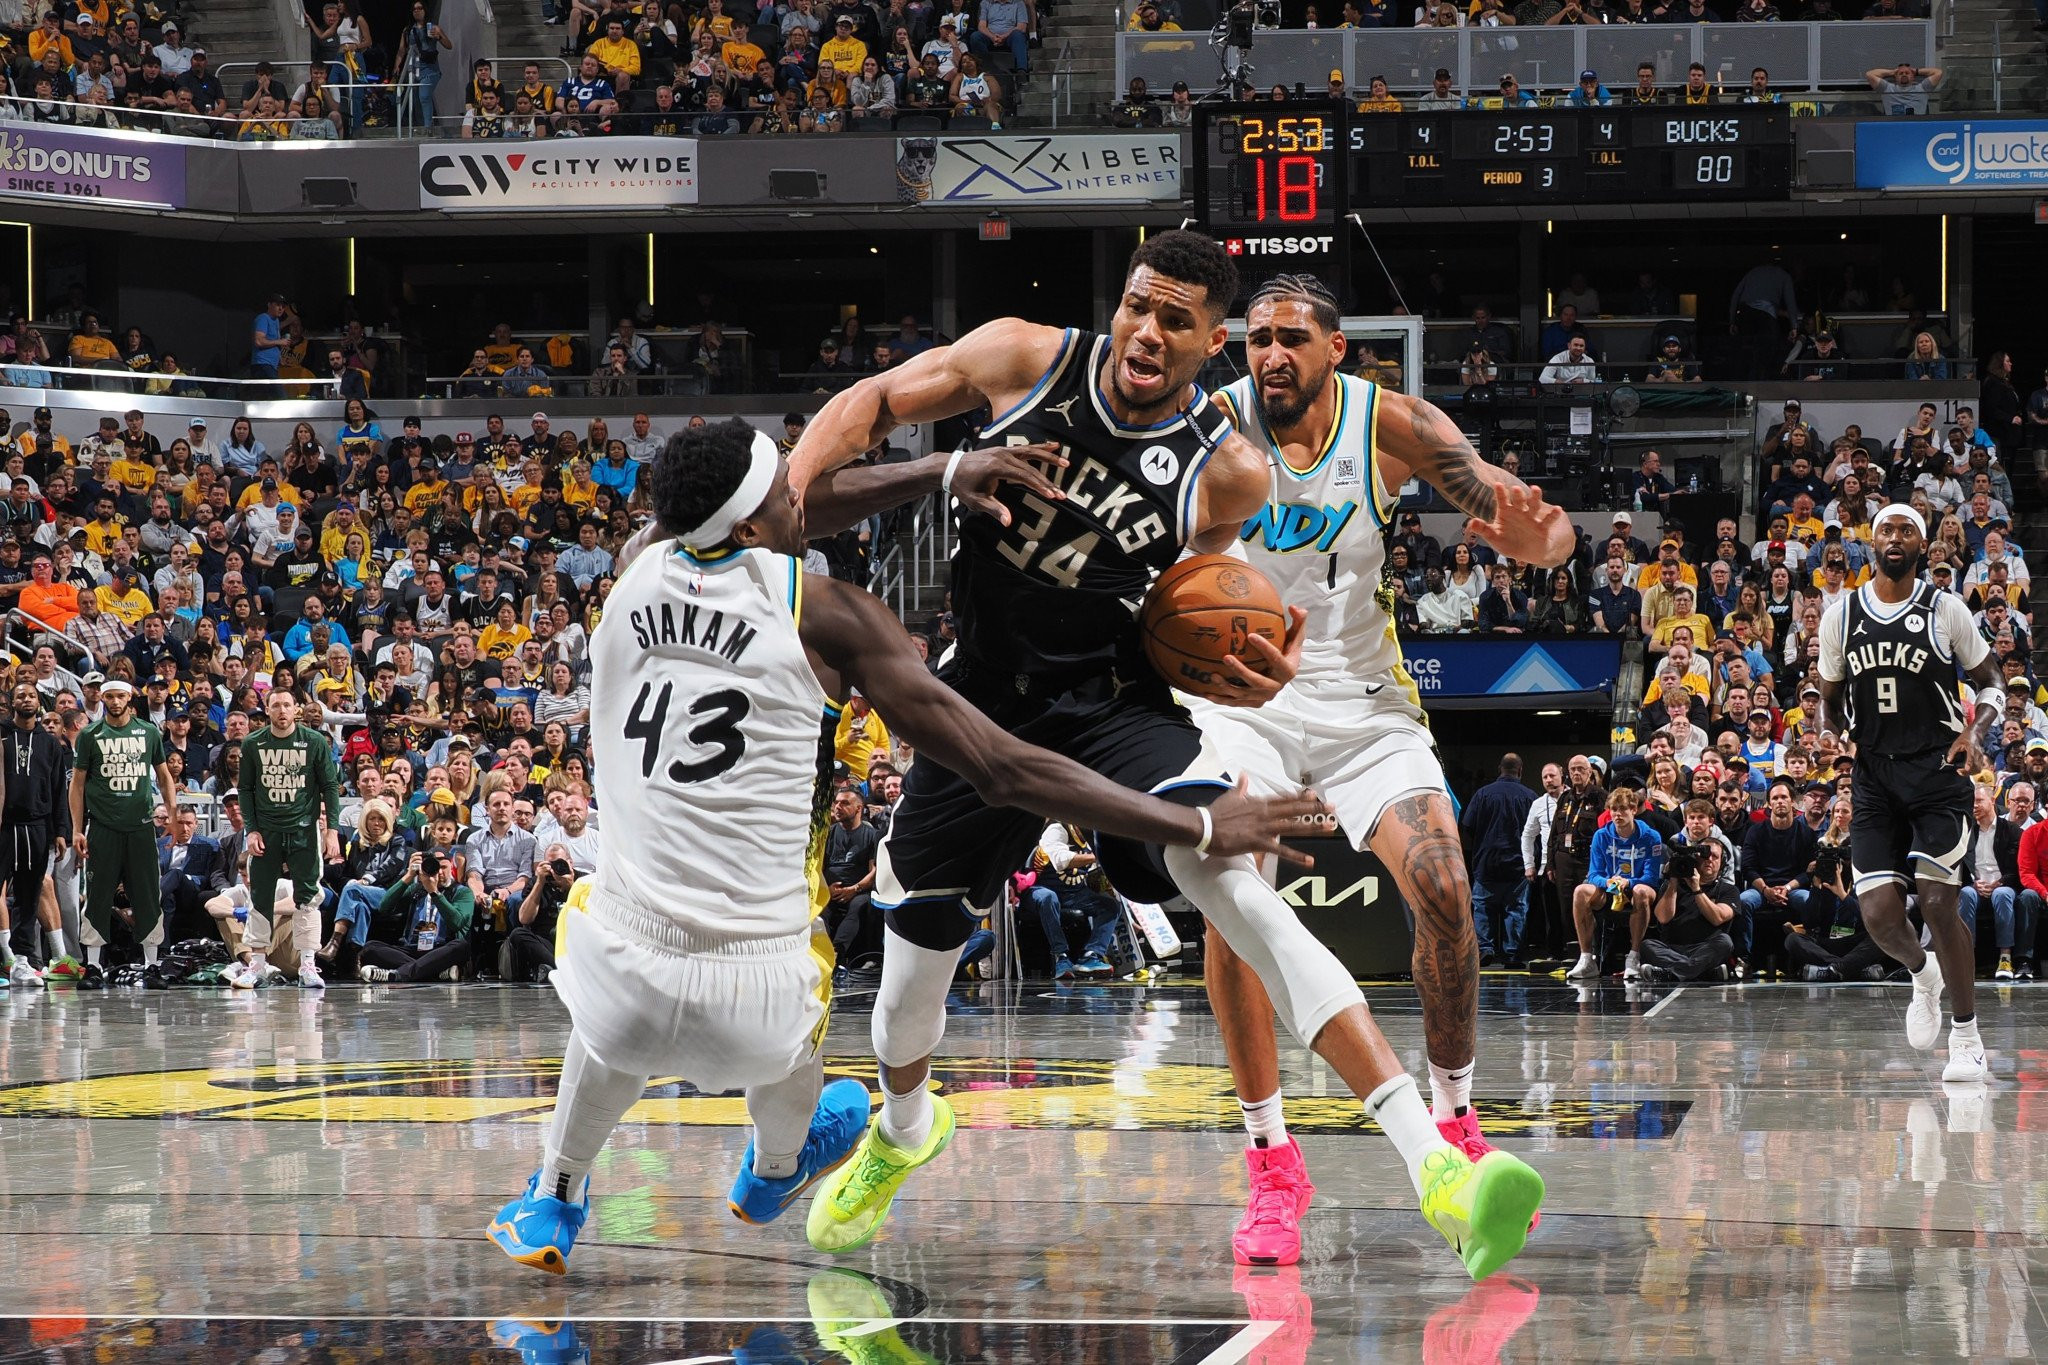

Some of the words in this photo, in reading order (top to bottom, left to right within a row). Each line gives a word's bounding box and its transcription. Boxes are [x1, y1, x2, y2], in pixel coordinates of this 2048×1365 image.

[1243, 118, 1322, 153] 2:53
[1417, 127, 1430, 144] 4
[1495, 125, 1554, 152] 2:53
[1600, 123, 1613, 140] 4
[1666, 119, 1739, 143] BUCKS
[29, 147, 151, 182] DONUTS
[532, 159, 600, 175] CITY
[614, 157, 690, 173] WIDE
[1049, 146, 1179, 172] XIBER
[1408, 154, 1439, 168] T.O.L.
[1483, 171, 1522, 185] PERIOD
[1542, 168, 1553, 187] 3
[1697, 155, 1732, 182] 80
[1974, 171, 2022, 180] SOFTENERS
[8, 177, 55, 193] SINCE
[64, 182, 102, 197] 1961
[532, 181, 599, 189] FACILITY
[610, 179, 692, 187] SOLUTIONS
[1068, 170, 1176, 190] INTERNET
[1256, 156, 1317, 223] 18
[983, 221, 1007, 237] EXIT
[1245, 237, 1334, 255] TISSOT
[1186, 413, 1213, 448] BRIDGEMAN
[1239, 500, 1359, 553] NDY
[996, 492, 1101, 589] 34
[1326, 552, 1339, 591] 1
[630, 602, 758, 664] SIAKAM
[1402, 658, 1442, 674] nce
[1847, 641, 1929, 677] BUCKS
[1415, 675, 1442, 690] lth
[1876, 677, 1899, 713] 9
[623, 679, 751, 784] 43
[97, 737, 146, 754] WIN
[103, 753, 127, 764] FOR
[258, 749, 307, 767] WIN
[100, 762, 147, 777] CREAM
[262, 766, 286, 775] FOR
[109, 777, 139, 791] CITY
[260, 774, 306, 789] CREAM
[268, 788, 298, 802] CITY
